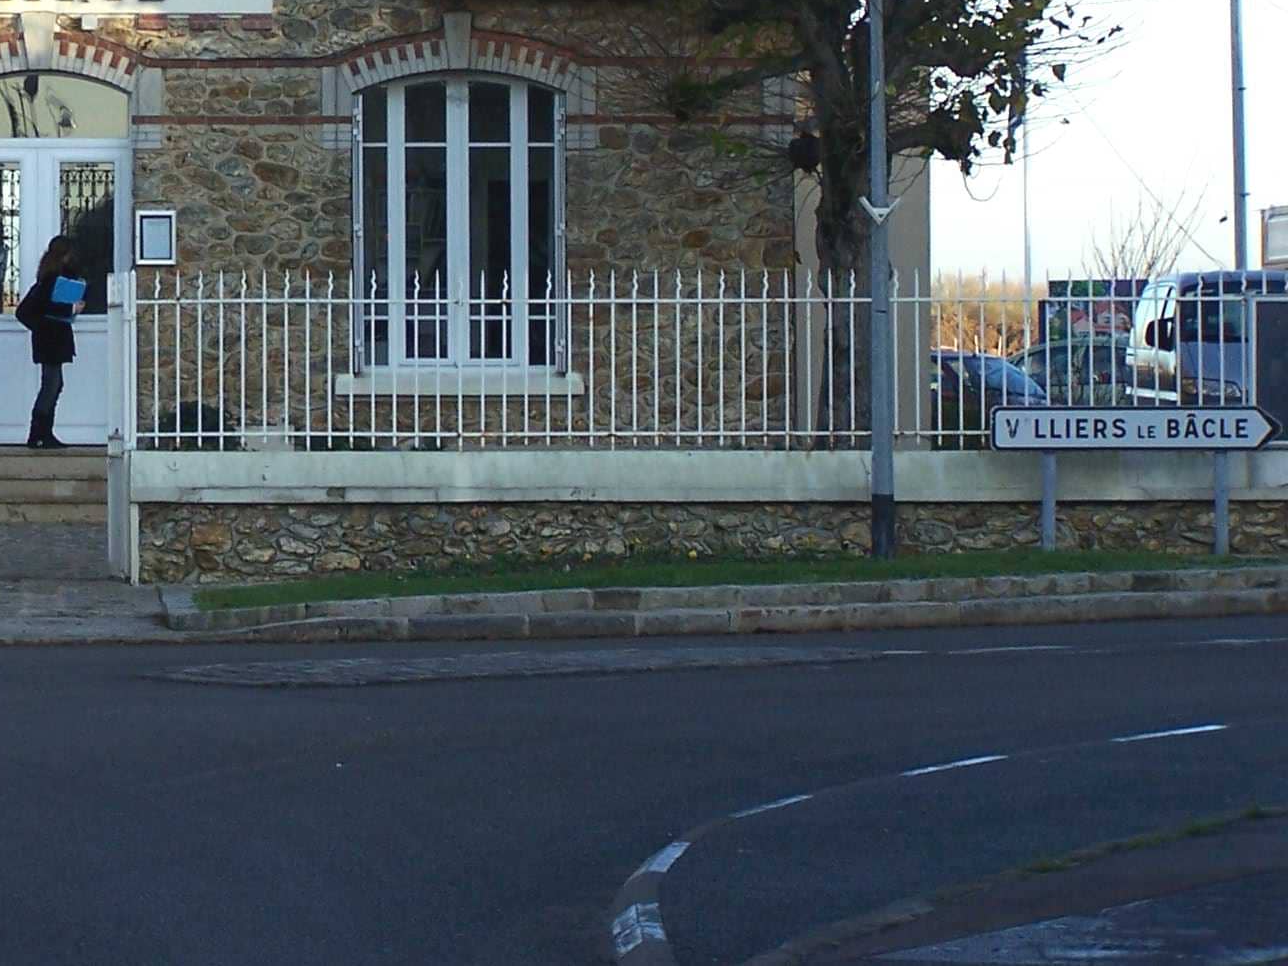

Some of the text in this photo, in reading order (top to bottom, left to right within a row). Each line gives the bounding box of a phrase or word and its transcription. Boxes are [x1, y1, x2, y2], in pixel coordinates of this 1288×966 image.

[1005, 414, 1249, 439] VLLIERS LE BÂCLE
